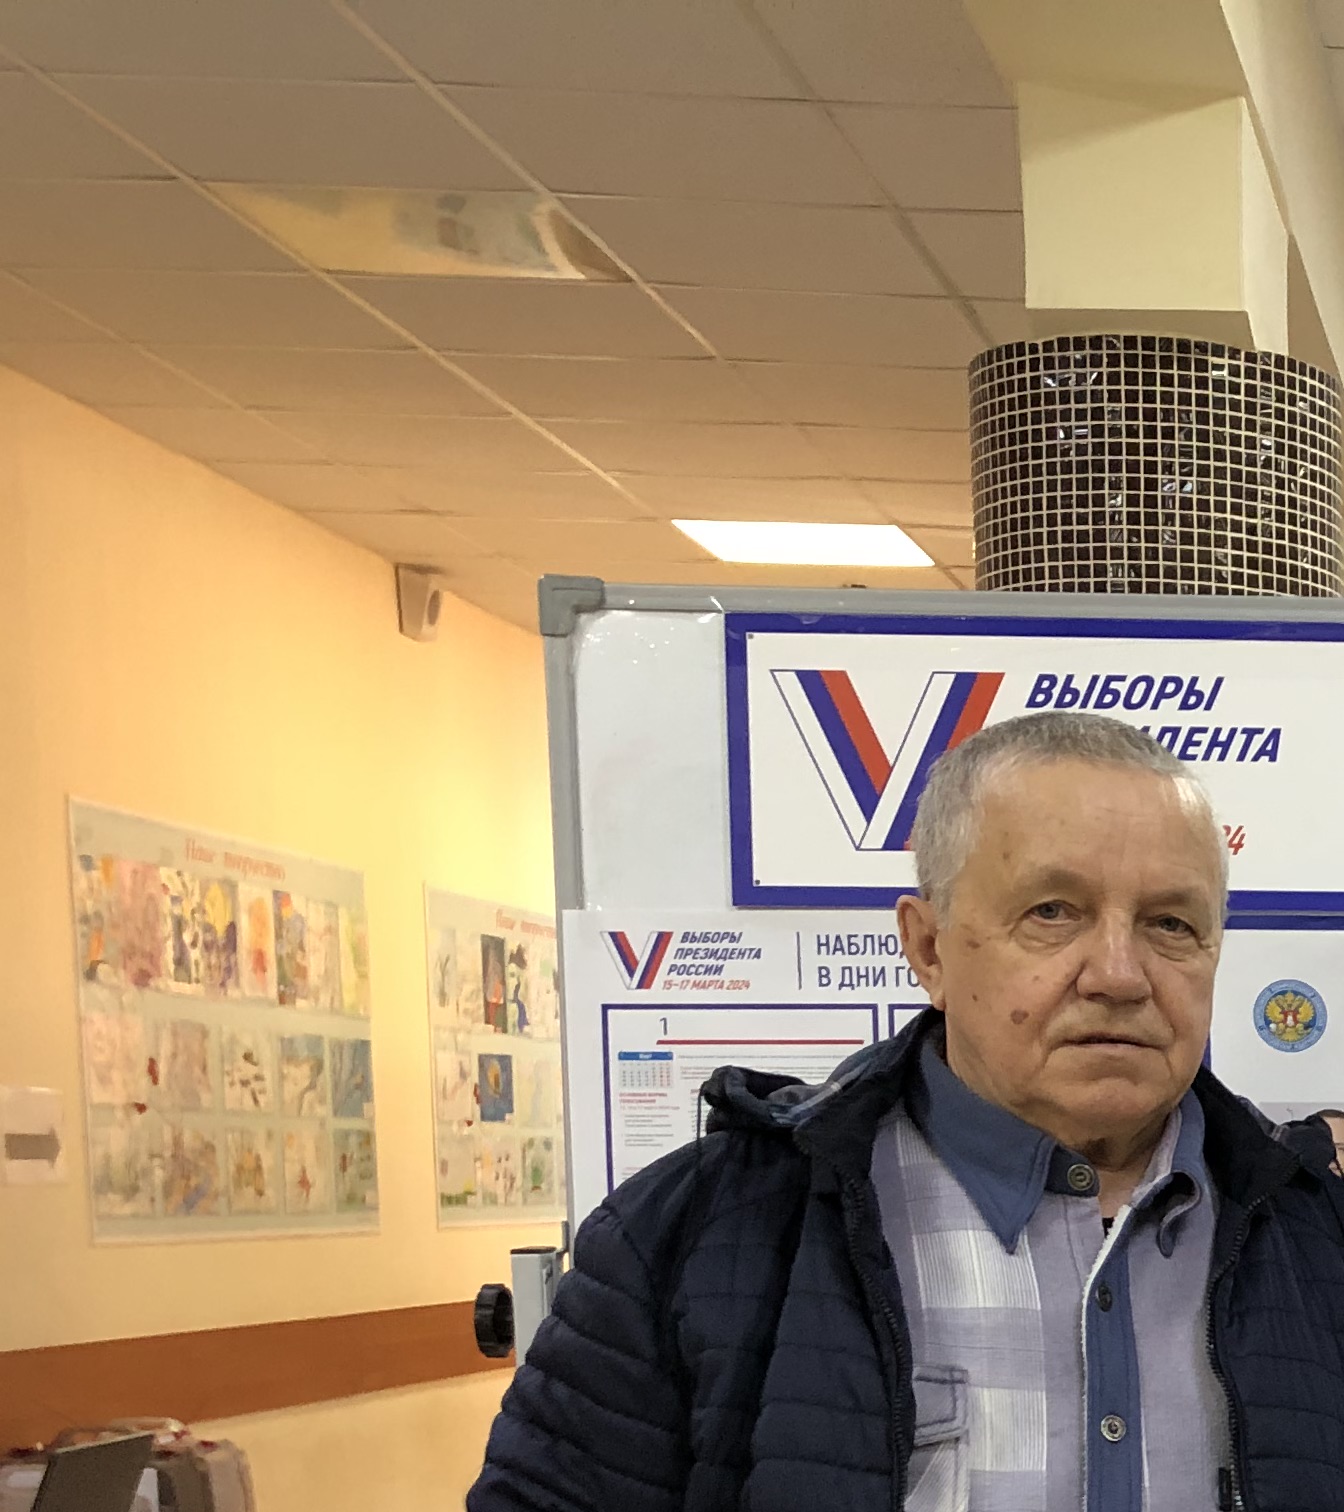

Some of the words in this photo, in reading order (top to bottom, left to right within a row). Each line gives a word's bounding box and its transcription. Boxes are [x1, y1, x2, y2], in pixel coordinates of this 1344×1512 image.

[1024, 672, 1225, 712] ВЫБОРЫ
[1139, 724, 1283, 763] ДЕНТА
[679, 931, 743, 944] ВЫБОРЫ
[816, 933, 906, 960] НАБЛЮ
[673, 947, 762, 961] ПРЕЗИДЕНТА
[666, 963, 725, 977] РОССИИ
[817, 965, 832, 988] В
[838, 965, 887, 991] ДНИ
[895, 965, 922, 988] ГО
[690, 979, 726, 991] МАРТА
[726, 979, 751, 991] 2024
[659, 1016, 669, 1037] 1
